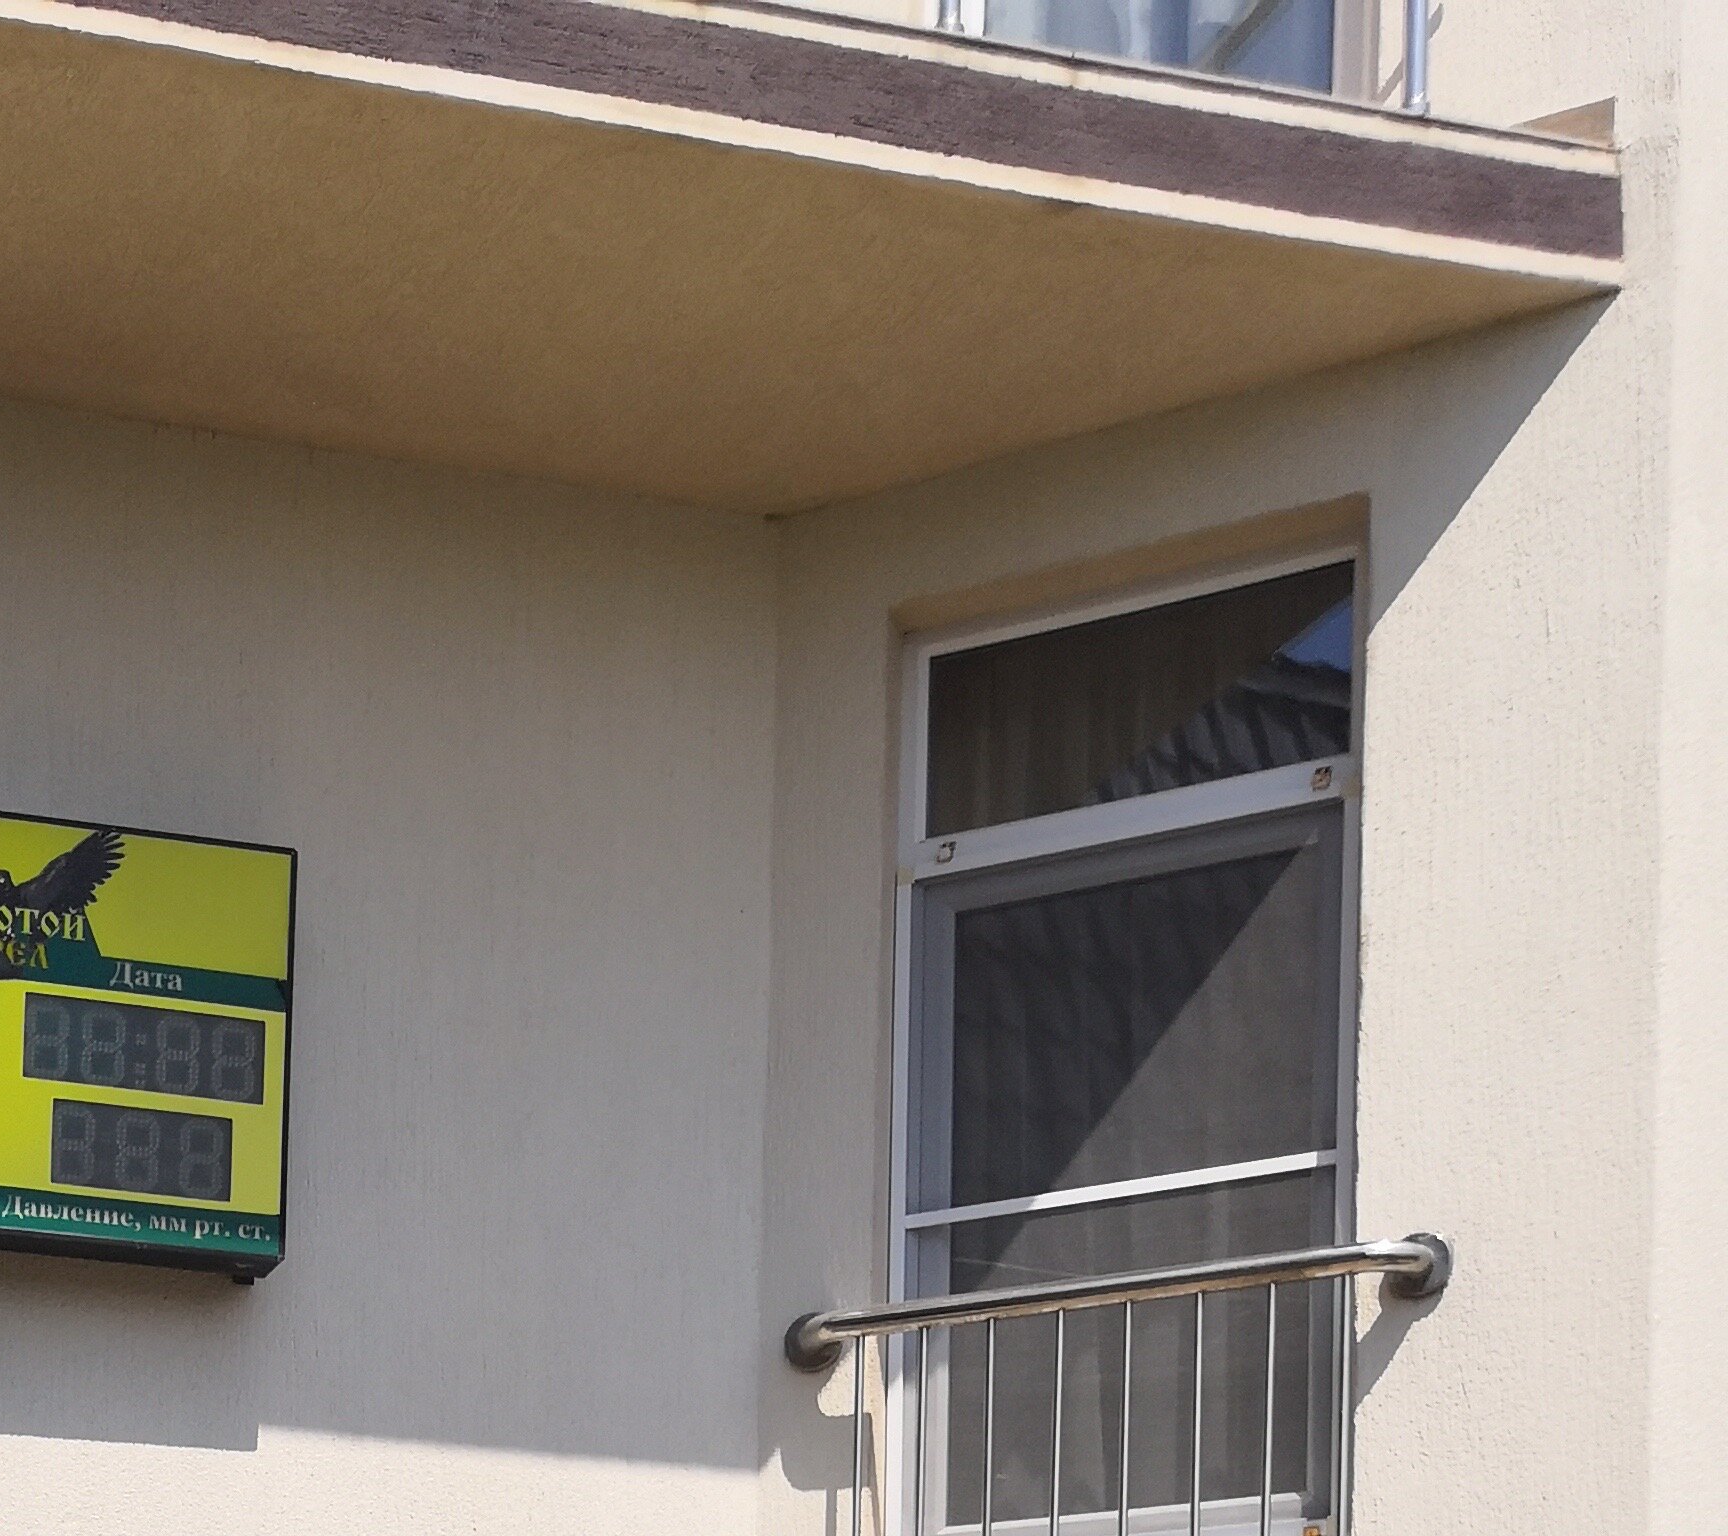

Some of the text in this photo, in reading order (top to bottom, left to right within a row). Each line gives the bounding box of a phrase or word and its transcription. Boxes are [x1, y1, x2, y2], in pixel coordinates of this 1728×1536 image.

[108, 961, 185, 993] Дата
[1, 1195, 272, 1242] Давление, мм рт. ст.
